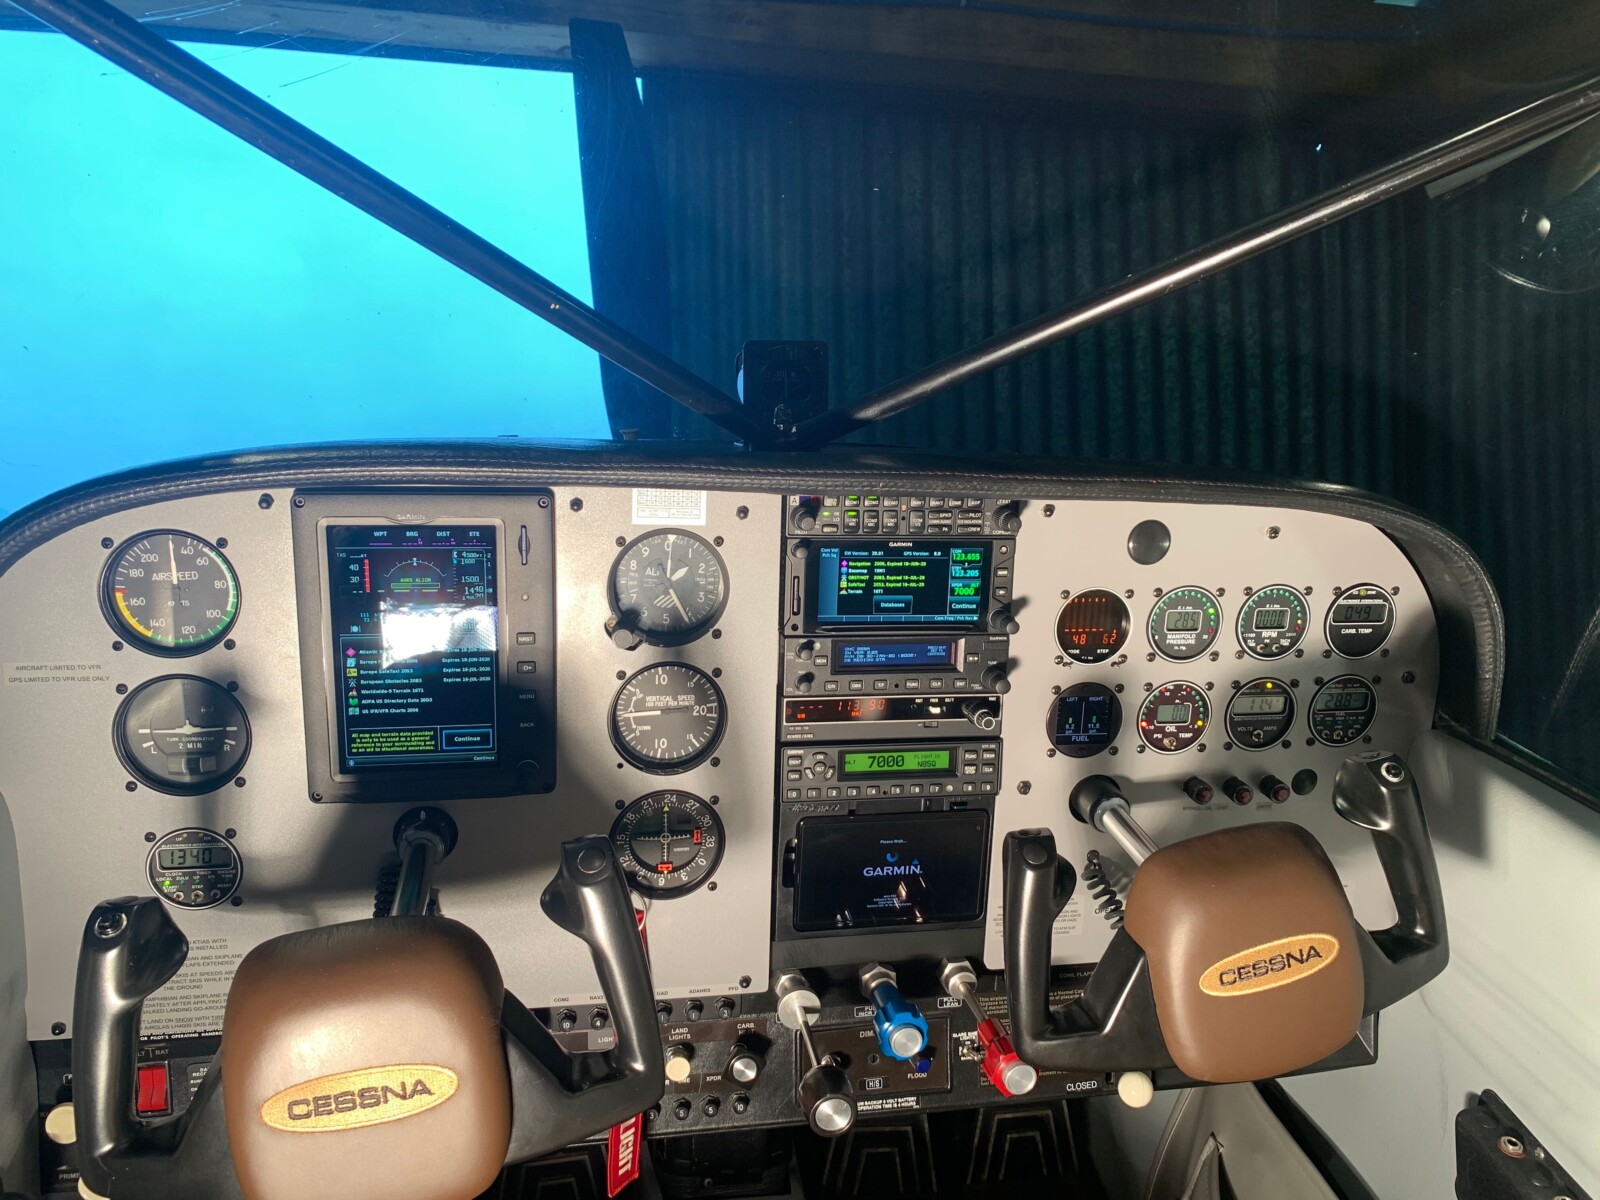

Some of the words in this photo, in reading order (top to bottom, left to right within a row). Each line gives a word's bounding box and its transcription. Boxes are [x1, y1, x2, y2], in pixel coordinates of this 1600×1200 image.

[181, 547, 194, 555] 40
[642, 547, 649, 557] 9
[141, 554, 159, 562] 200
[196, 557, 209, 565] 60
[630, 560, 636, 570] 8
[699, 563, 705, 573] 2
[129, 569, 144, 577] 180
[214, 580, 226, 589] 80
[130, 597, 145, 606] 160
[630, 594, 636, 603] 7
[698, 592, 704, 602] 3
[206, 609, 221, 618] 100
[641, 607, 647, 617] 6
[150, 618, 165, 627] 140
[663, 614, 669, 623] 5
[182, 626, 195, 634] 120
[1073, 634, 1086, 644] 48
[656, 675, 667, 684] 10
[693, 706, 707, 715] 20
[655, 739, 667, 748] 10
[868, 756, 904, 768] 7000
[642, 799, 653, 809] 21
[686, 800, 699, 810] 27
[624, 813, 636, 824] 18
[701, 815, 712, 826] 30
[617, 834, 625, 844] 15
[706, 836, 715, 847] 33
[171, 849, 211, 865] 1340
[620, 855, 630, 866] 12
[863, 865, 920, 876] GARMIN
[1219, 945, 1323, 987] CESSNA
[1066, 1081, 1097, 1091] CLOSED
[288, 1079, 434, 1121] CESSNA
